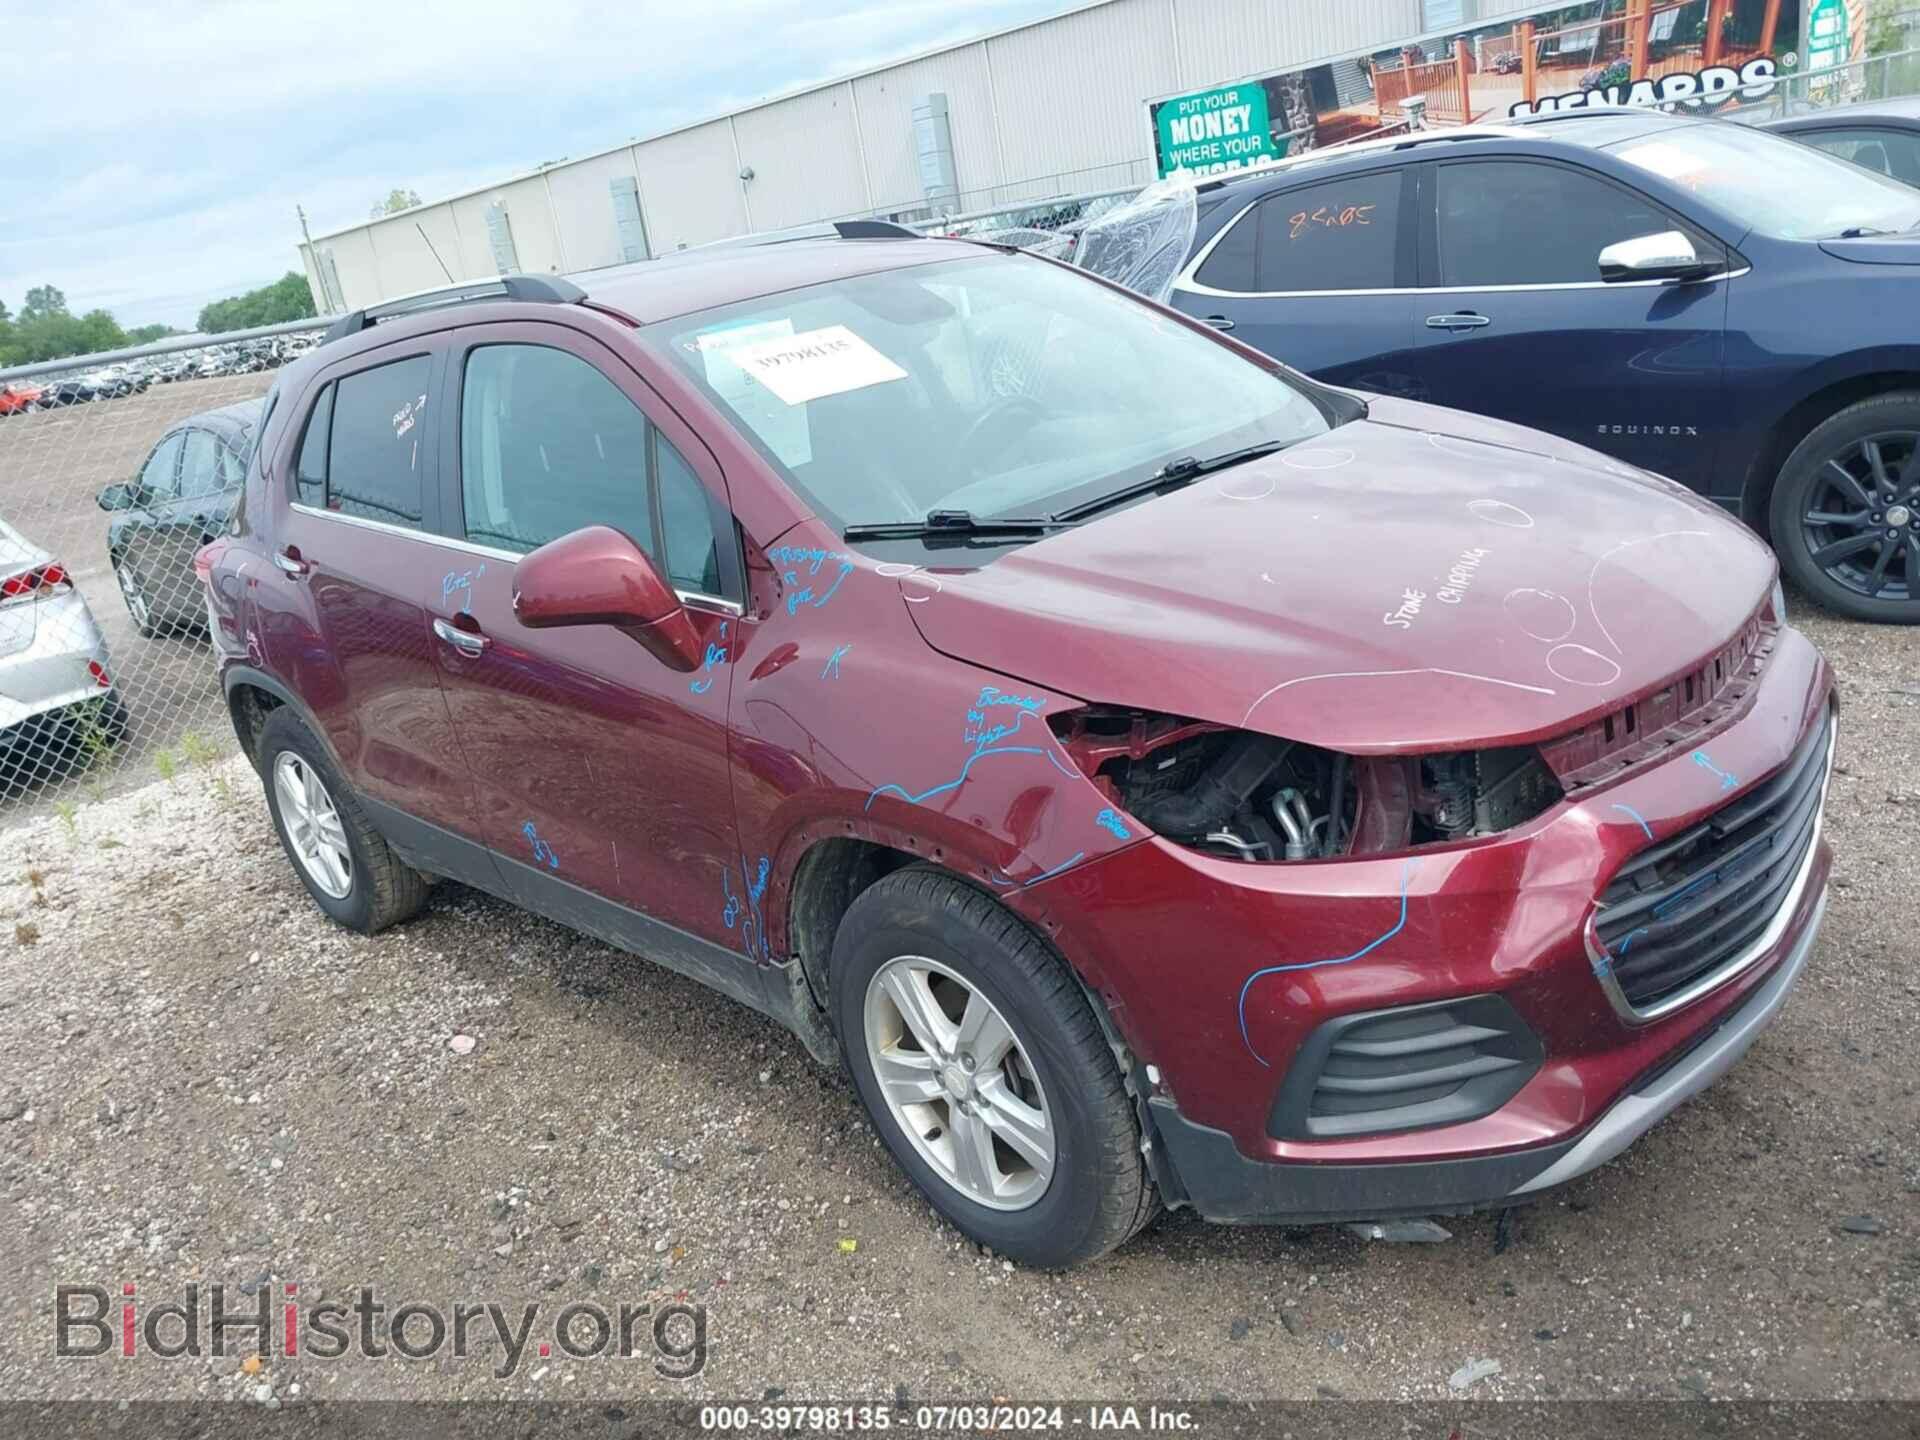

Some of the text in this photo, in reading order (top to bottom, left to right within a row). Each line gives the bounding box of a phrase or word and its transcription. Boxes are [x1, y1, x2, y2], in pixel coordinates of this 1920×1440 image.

[1179, 91, 1239, 115] PUT YOUR
[1169, 103, 1252, 146] MONEY
[1169, 142, 1221, 165] WHERE
[1222, 134, 1263, 156] YOUR
[1597, 424, 1698, 436] EQUINOX
[1436, 547, 1494, 604] CHIPPING
